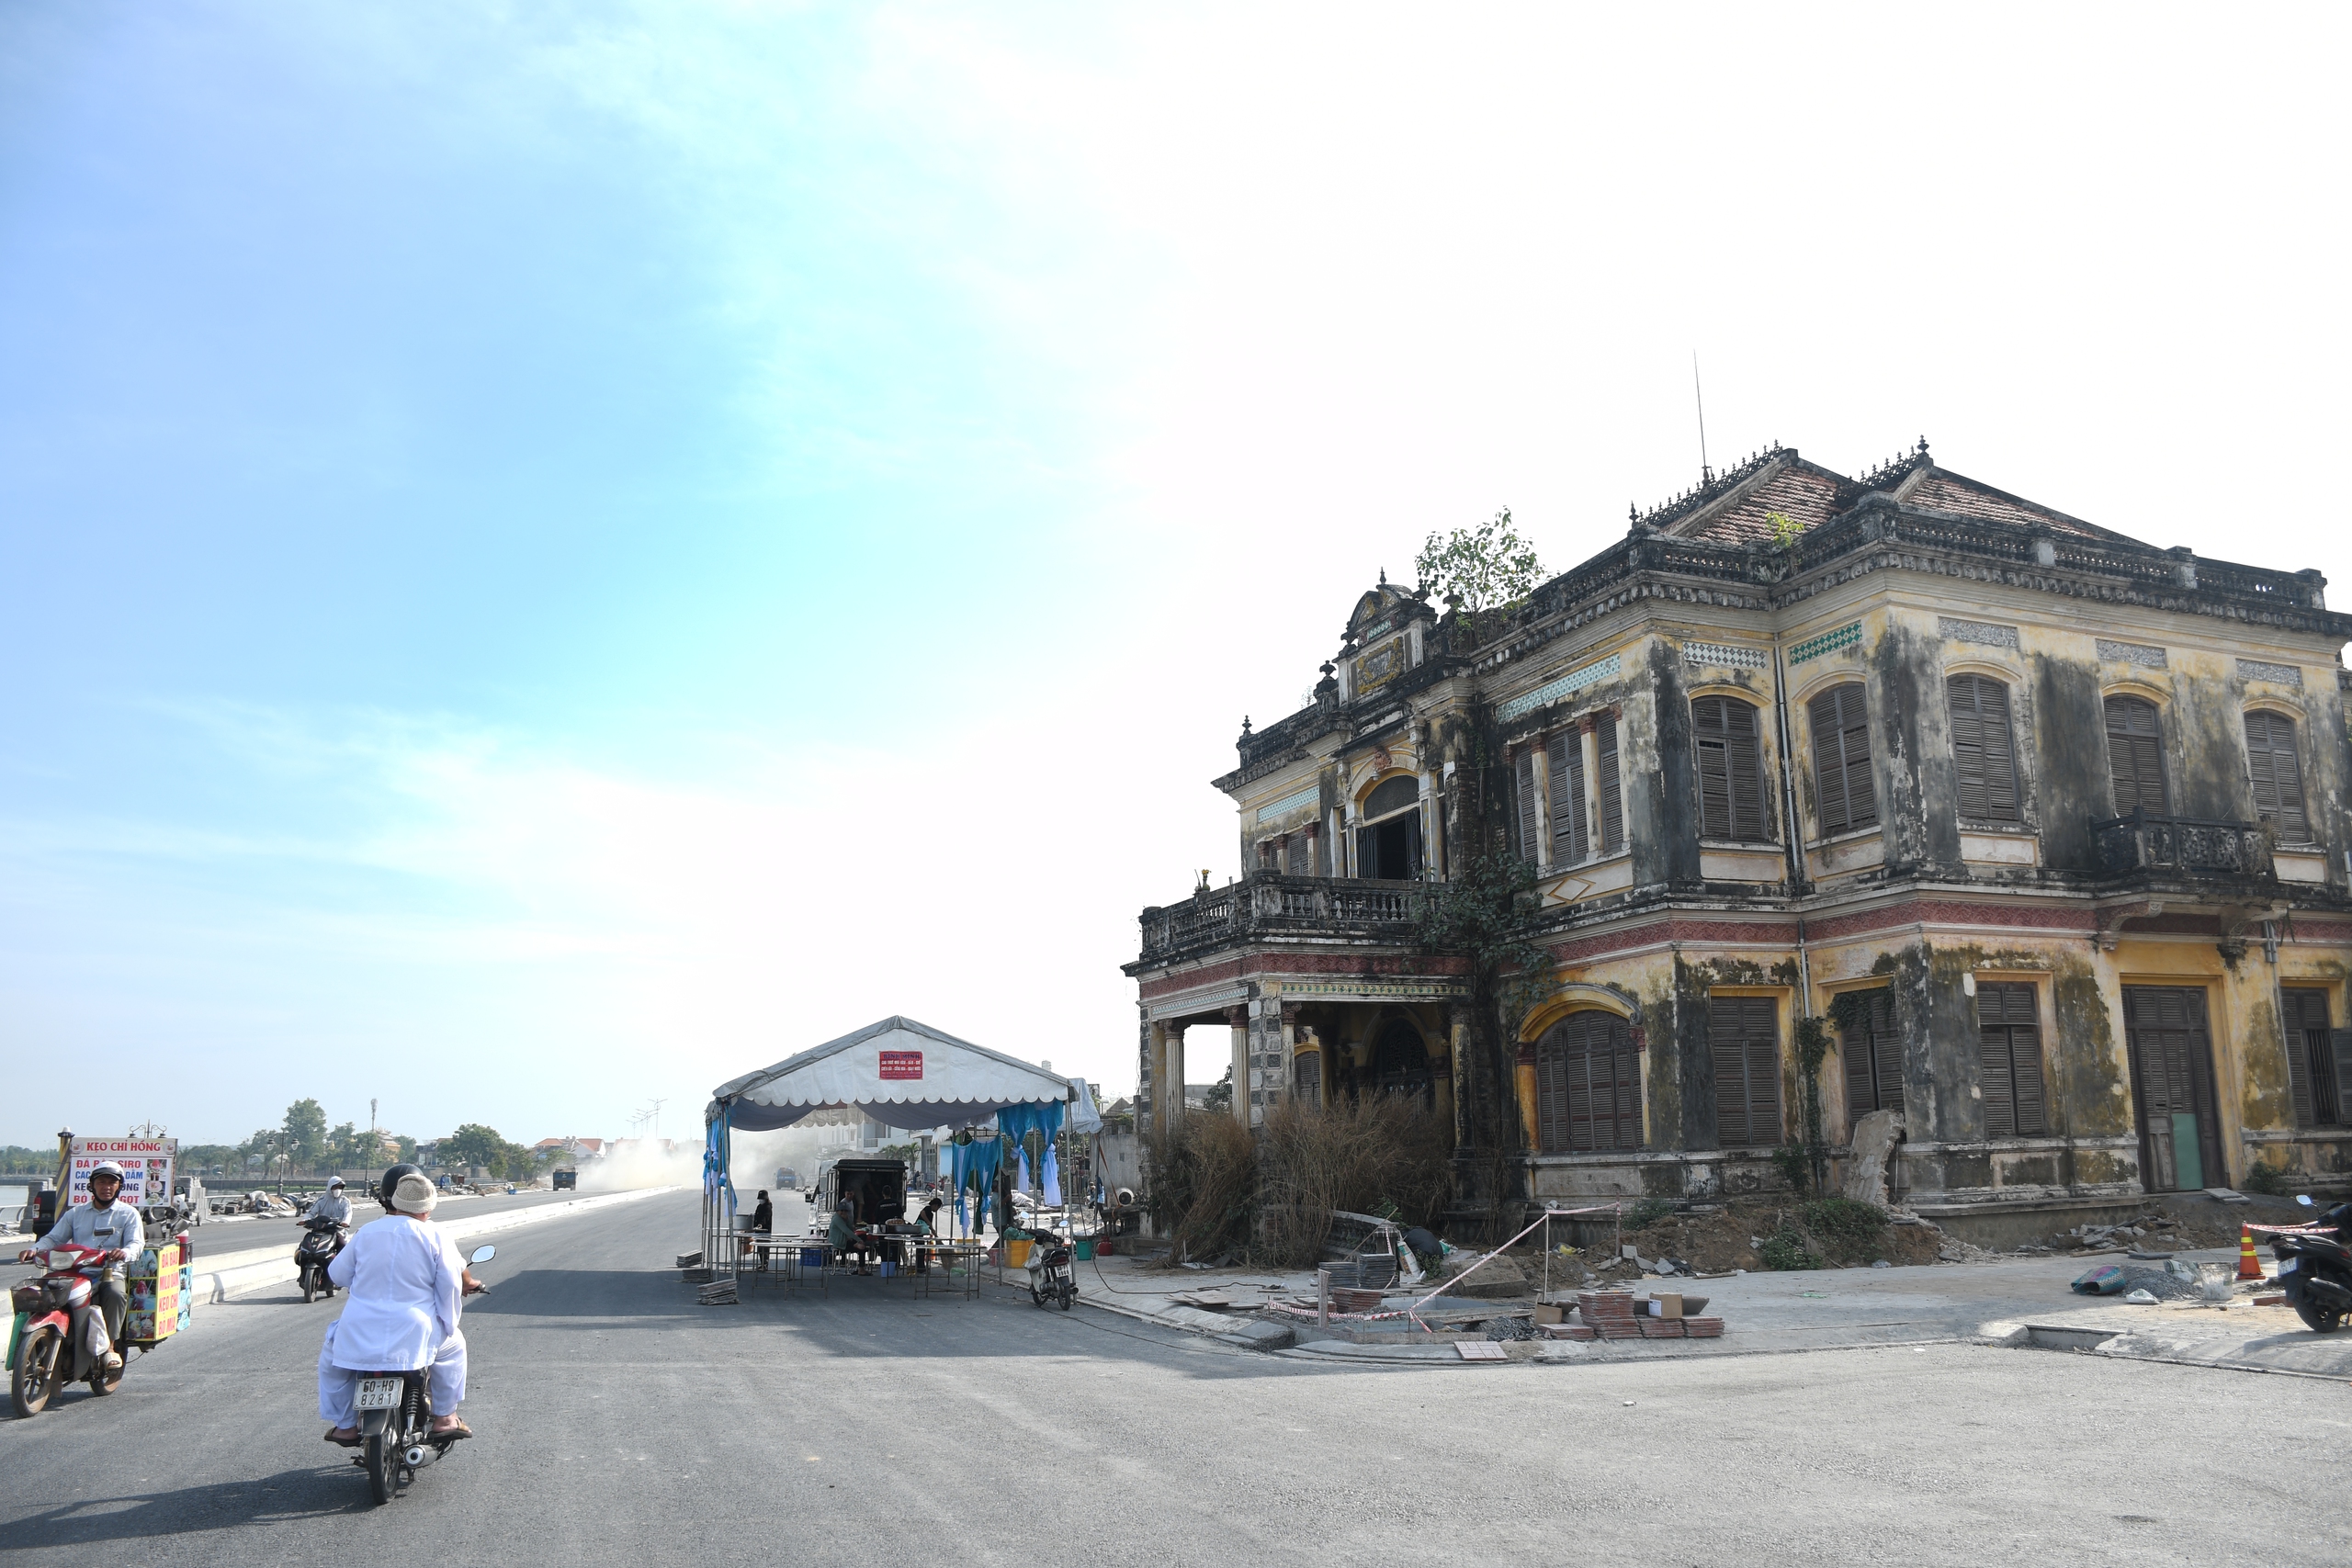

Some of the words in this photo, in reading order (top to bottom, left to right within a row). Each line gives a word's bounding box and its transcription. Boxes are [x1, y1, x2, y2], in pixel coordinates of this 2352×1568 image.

[86, 1142, 107, 1153] KẸO
[118, 1160, 141, 1168] SIRO
[363, 1380, 395, 1393] 60-H9
[360, 1393, 392, 1405] 8281
